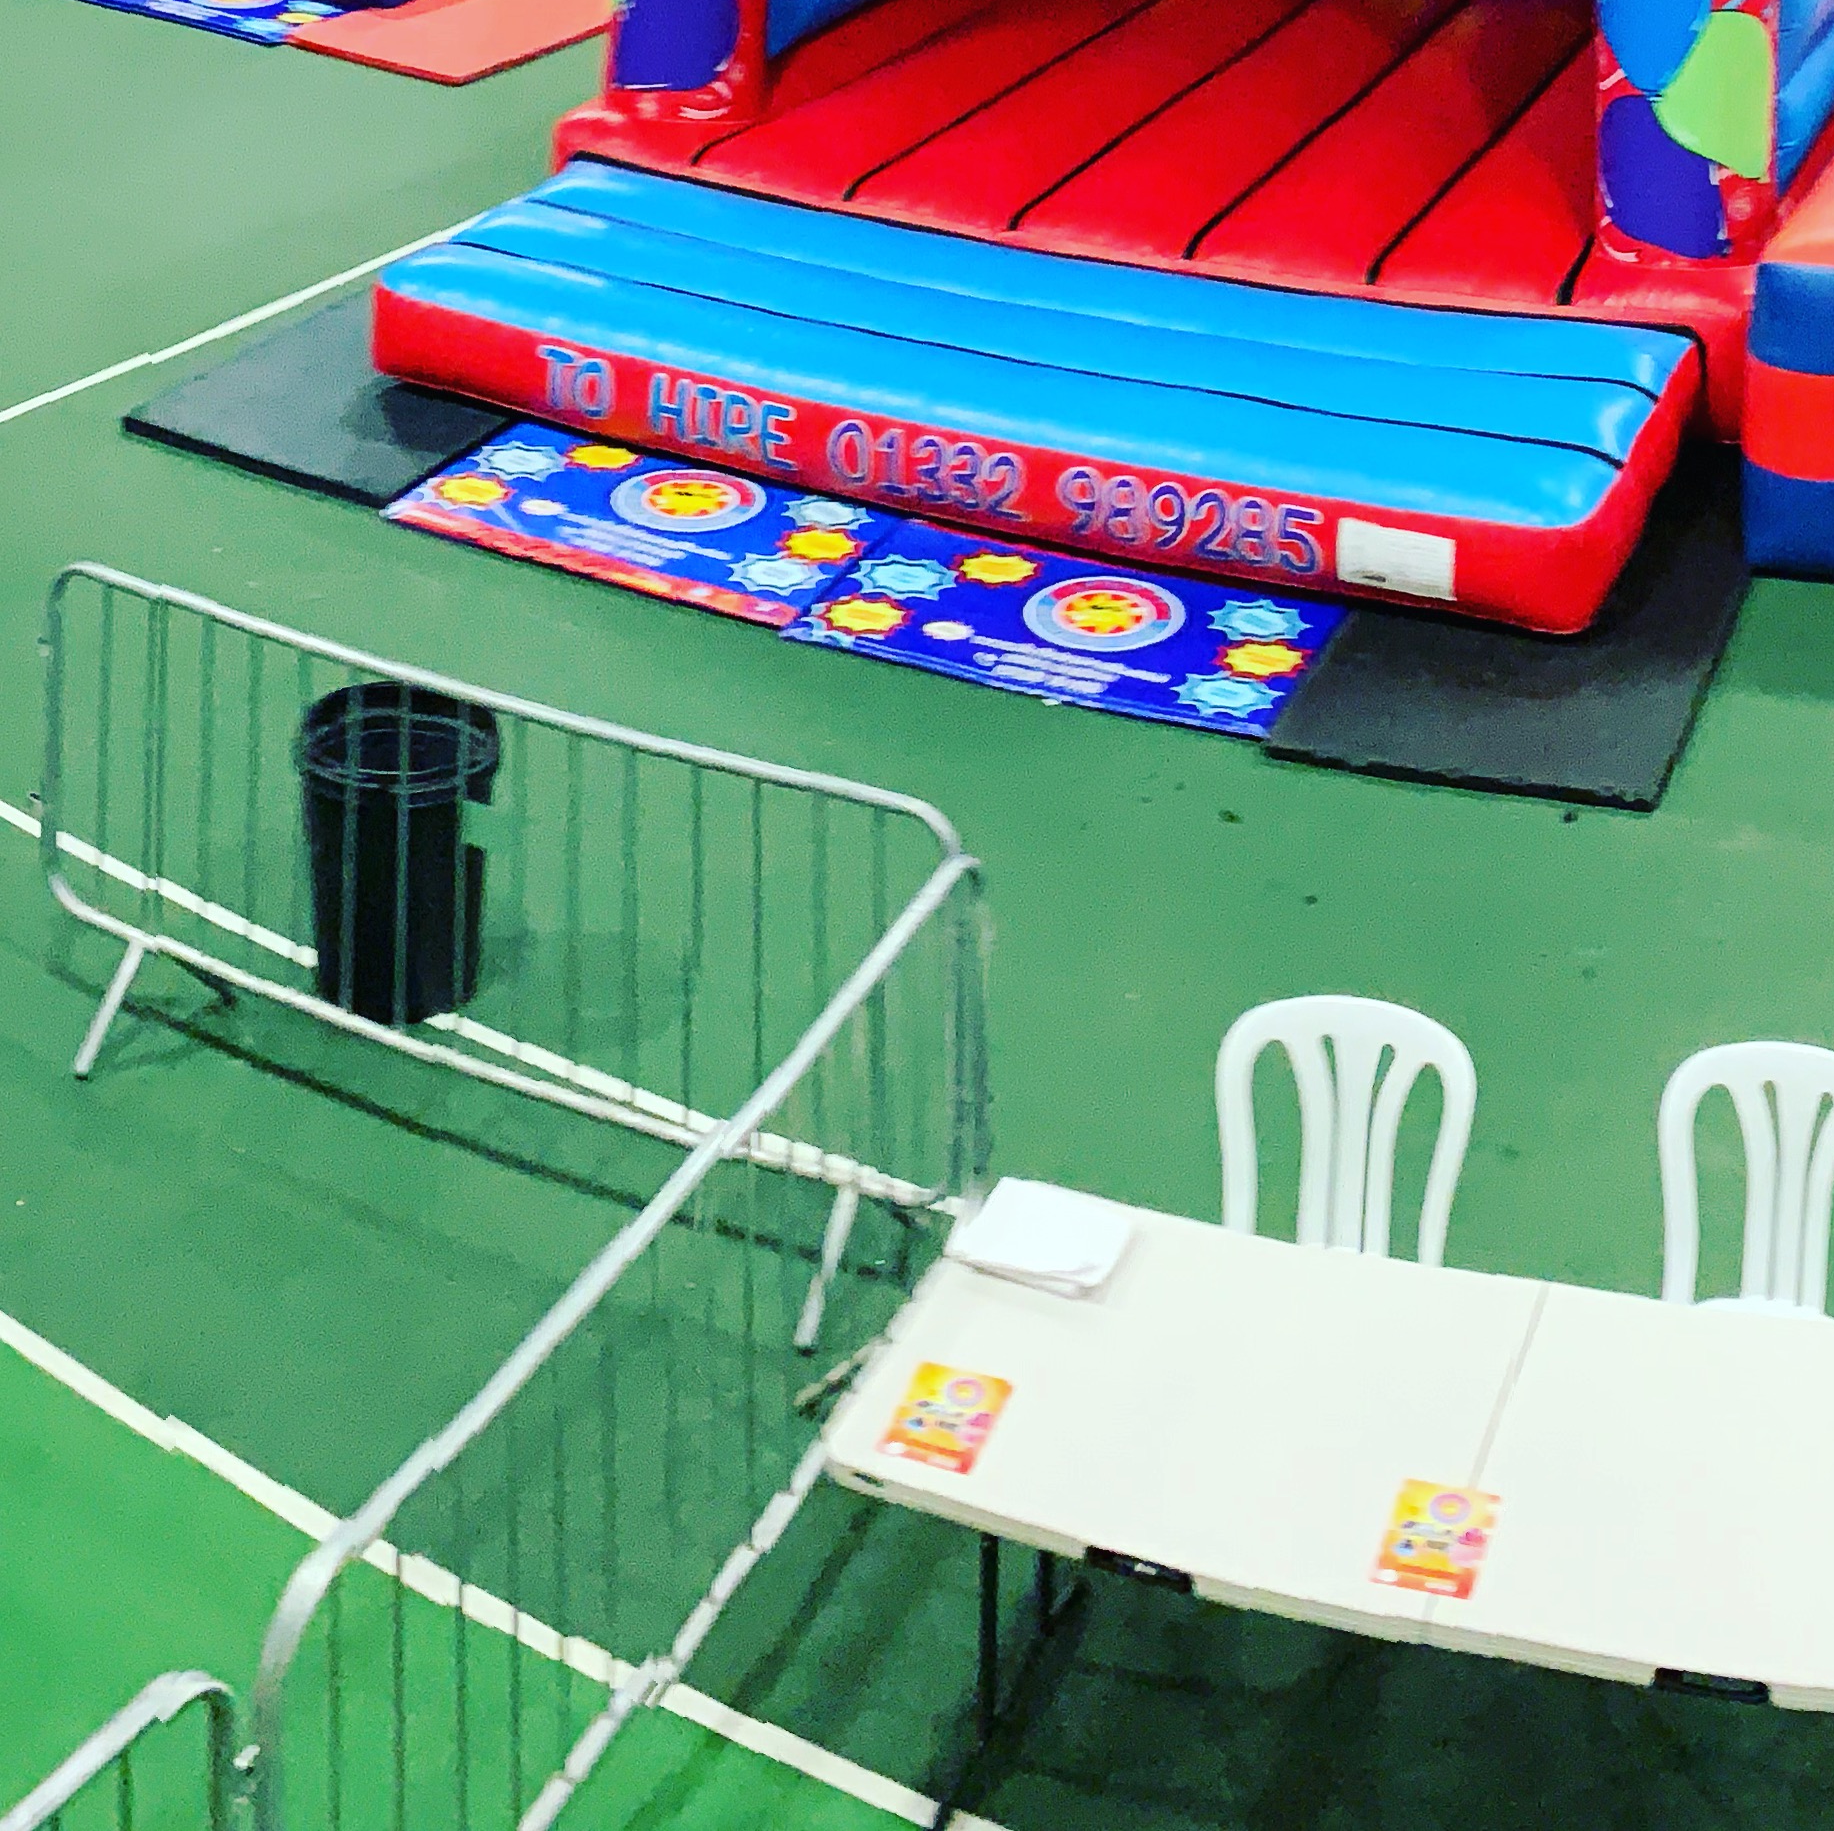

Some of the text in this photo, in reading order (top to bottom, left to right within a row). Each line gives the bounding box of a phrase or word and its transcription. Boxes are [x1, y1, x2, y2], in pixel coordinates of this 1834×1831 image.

[536, 344, 1324, 574] TO HIRE 01332 989285
